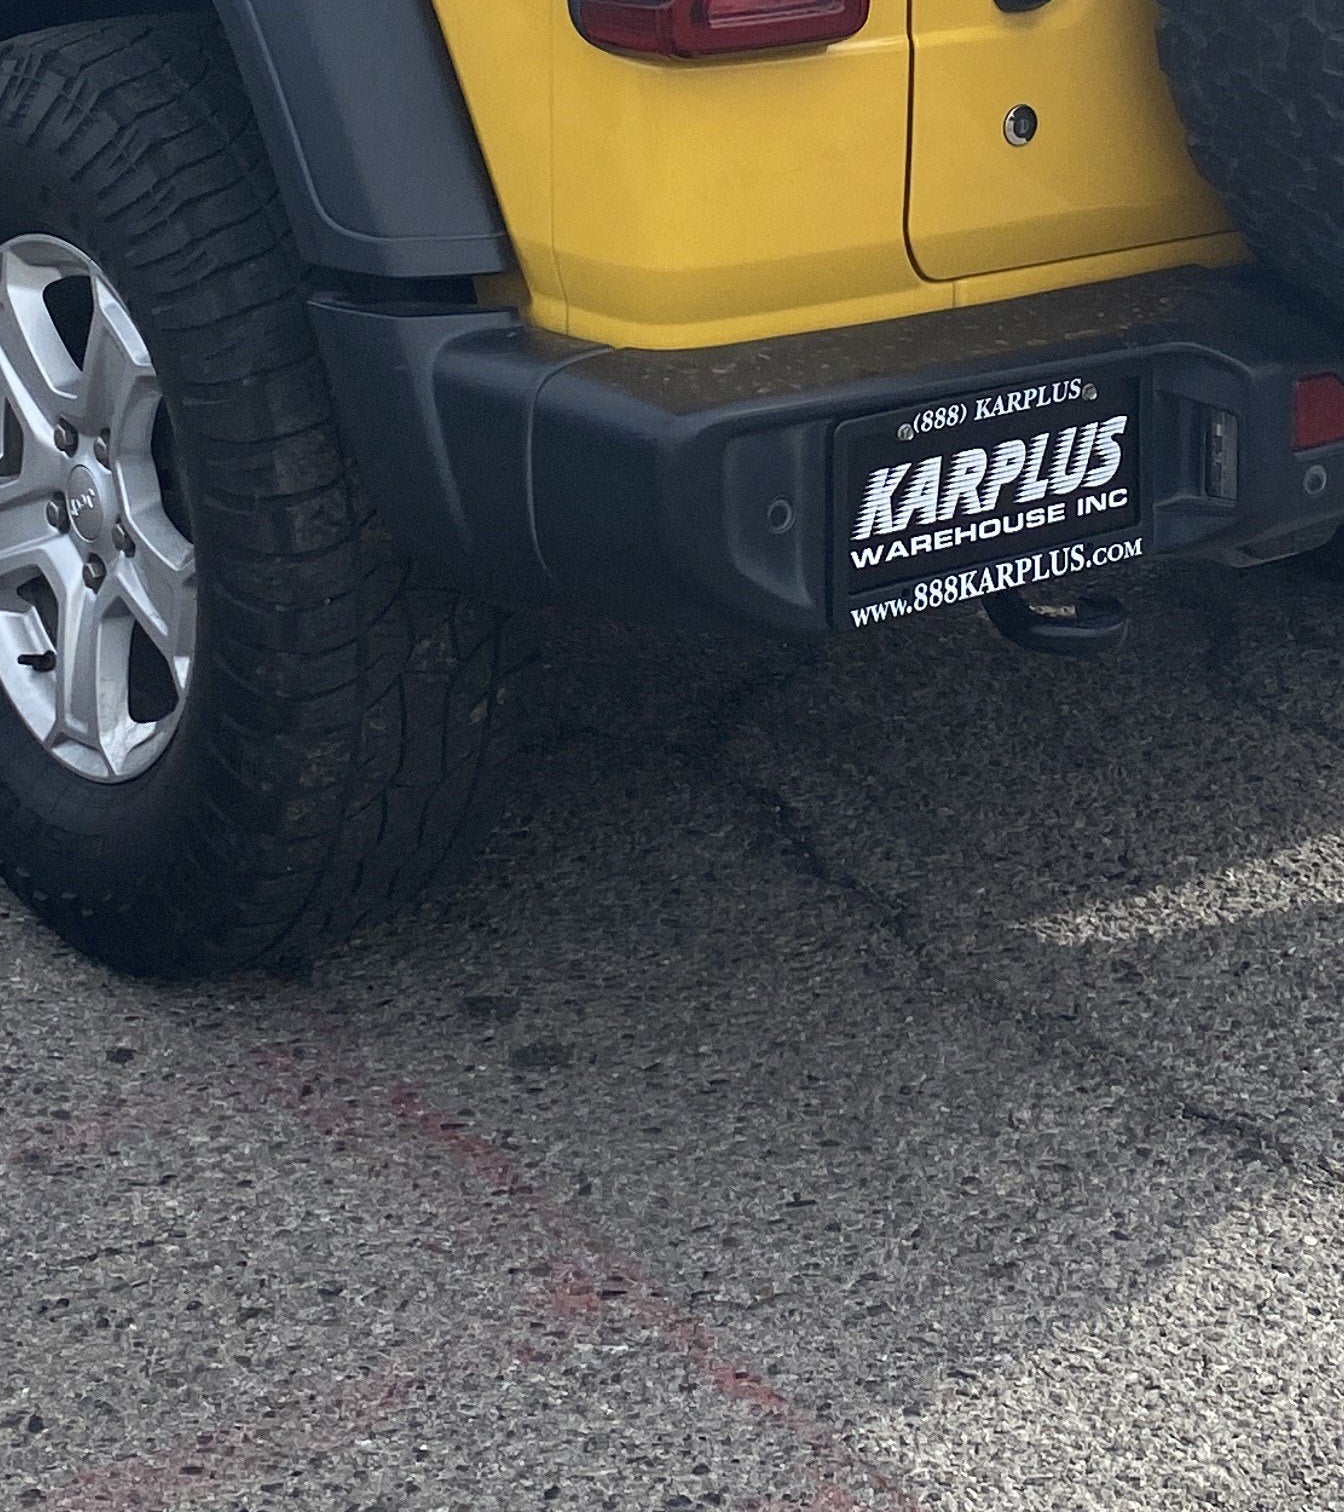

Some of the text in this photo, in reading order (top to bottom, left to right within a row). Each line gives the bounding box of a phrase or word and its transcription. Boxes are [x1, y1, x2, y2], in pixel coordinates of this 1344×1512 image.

[913, 378, 1083, 434] (888) KARPLUS
[850, 416, 1128, 540] KARPLUS
[850, 488, 1128, 569] WAREHOUSE INC
